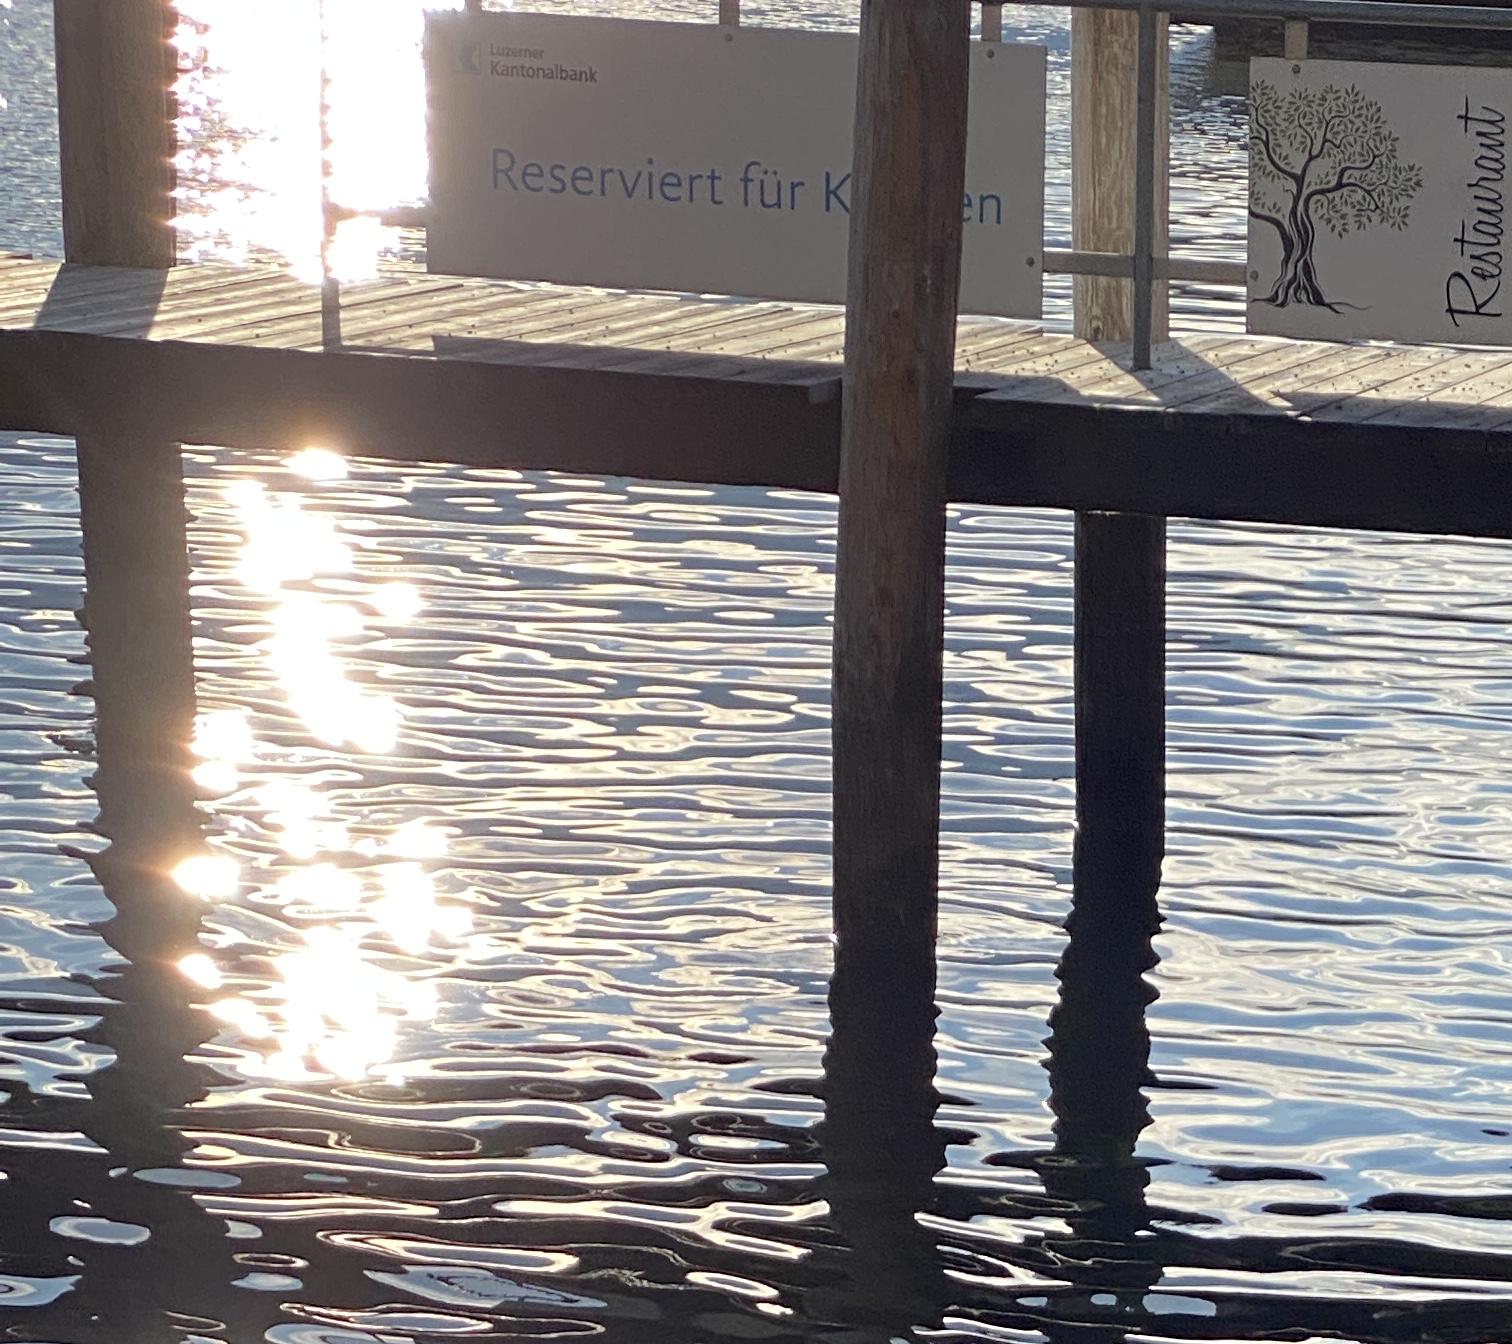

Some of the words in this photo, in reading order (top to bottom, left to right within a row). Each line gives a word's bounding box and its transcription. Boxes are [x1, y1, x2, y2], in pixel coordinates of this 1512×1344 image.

[489, 44, 545, 60] Luzerner
[489, 60, 598, 84] Kantonalbank
[491, 147, 724, 206] Reserviert
[739, 160, 805, 211] für
[1445, 95, 1506, 328] Restaurant
